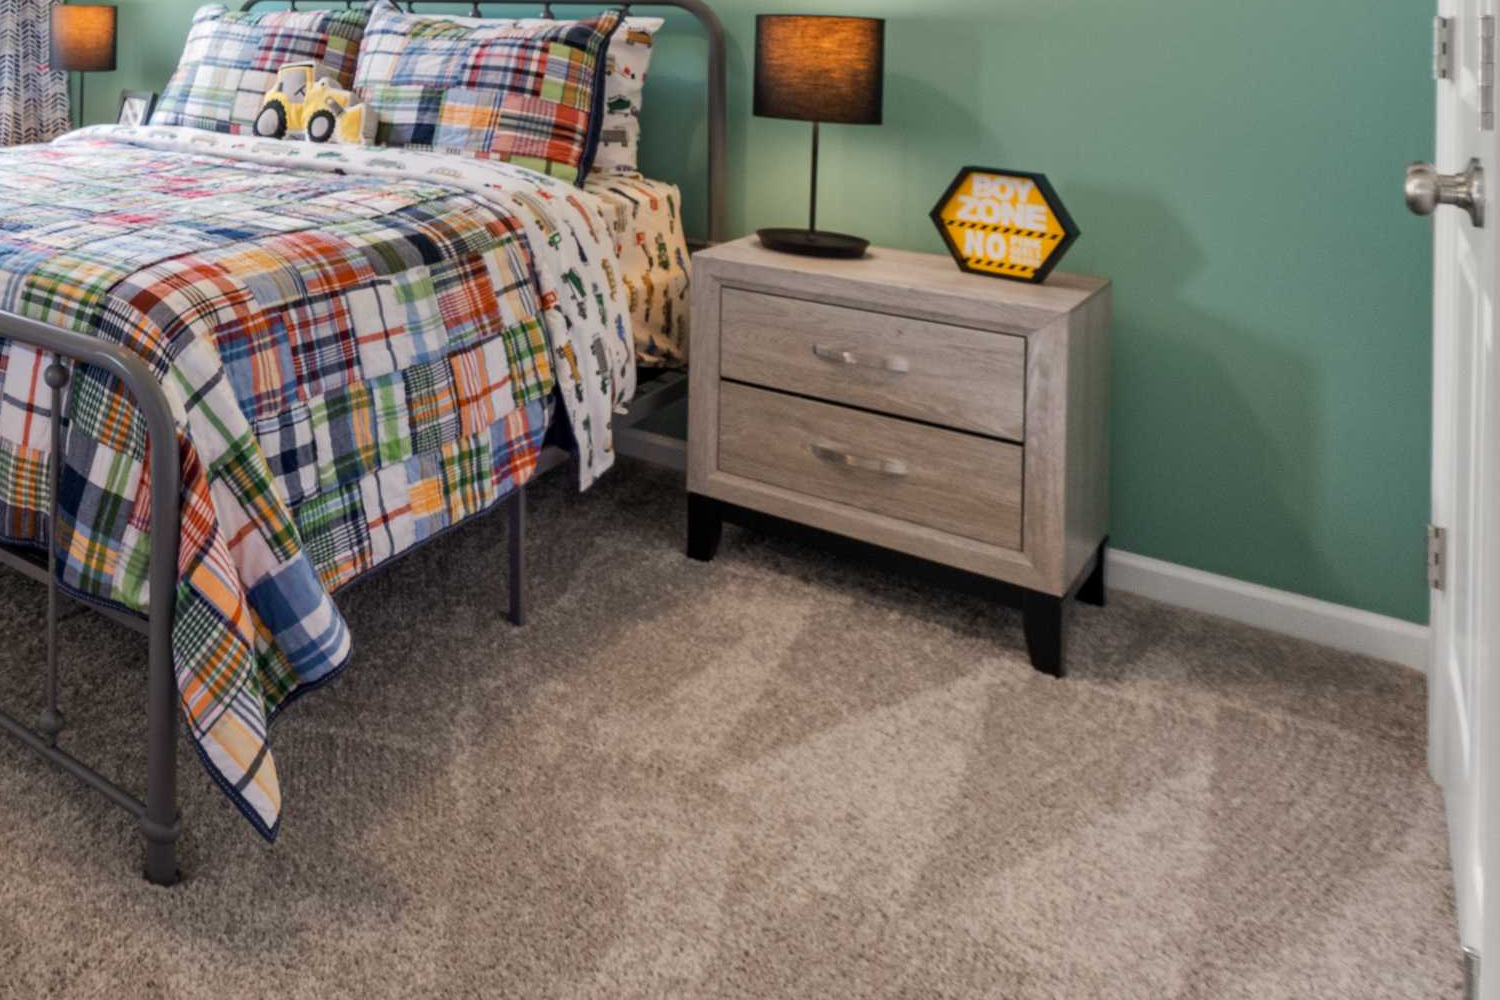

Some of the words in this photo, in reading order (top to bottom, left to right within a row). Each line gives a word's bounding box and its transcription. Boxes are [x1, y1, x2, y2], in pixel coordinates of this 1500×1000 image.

[972, 175, 1033, 202] BOY
[957, 195, 1048, 232] ZONE
[964, 230, 1006, 260] NO
